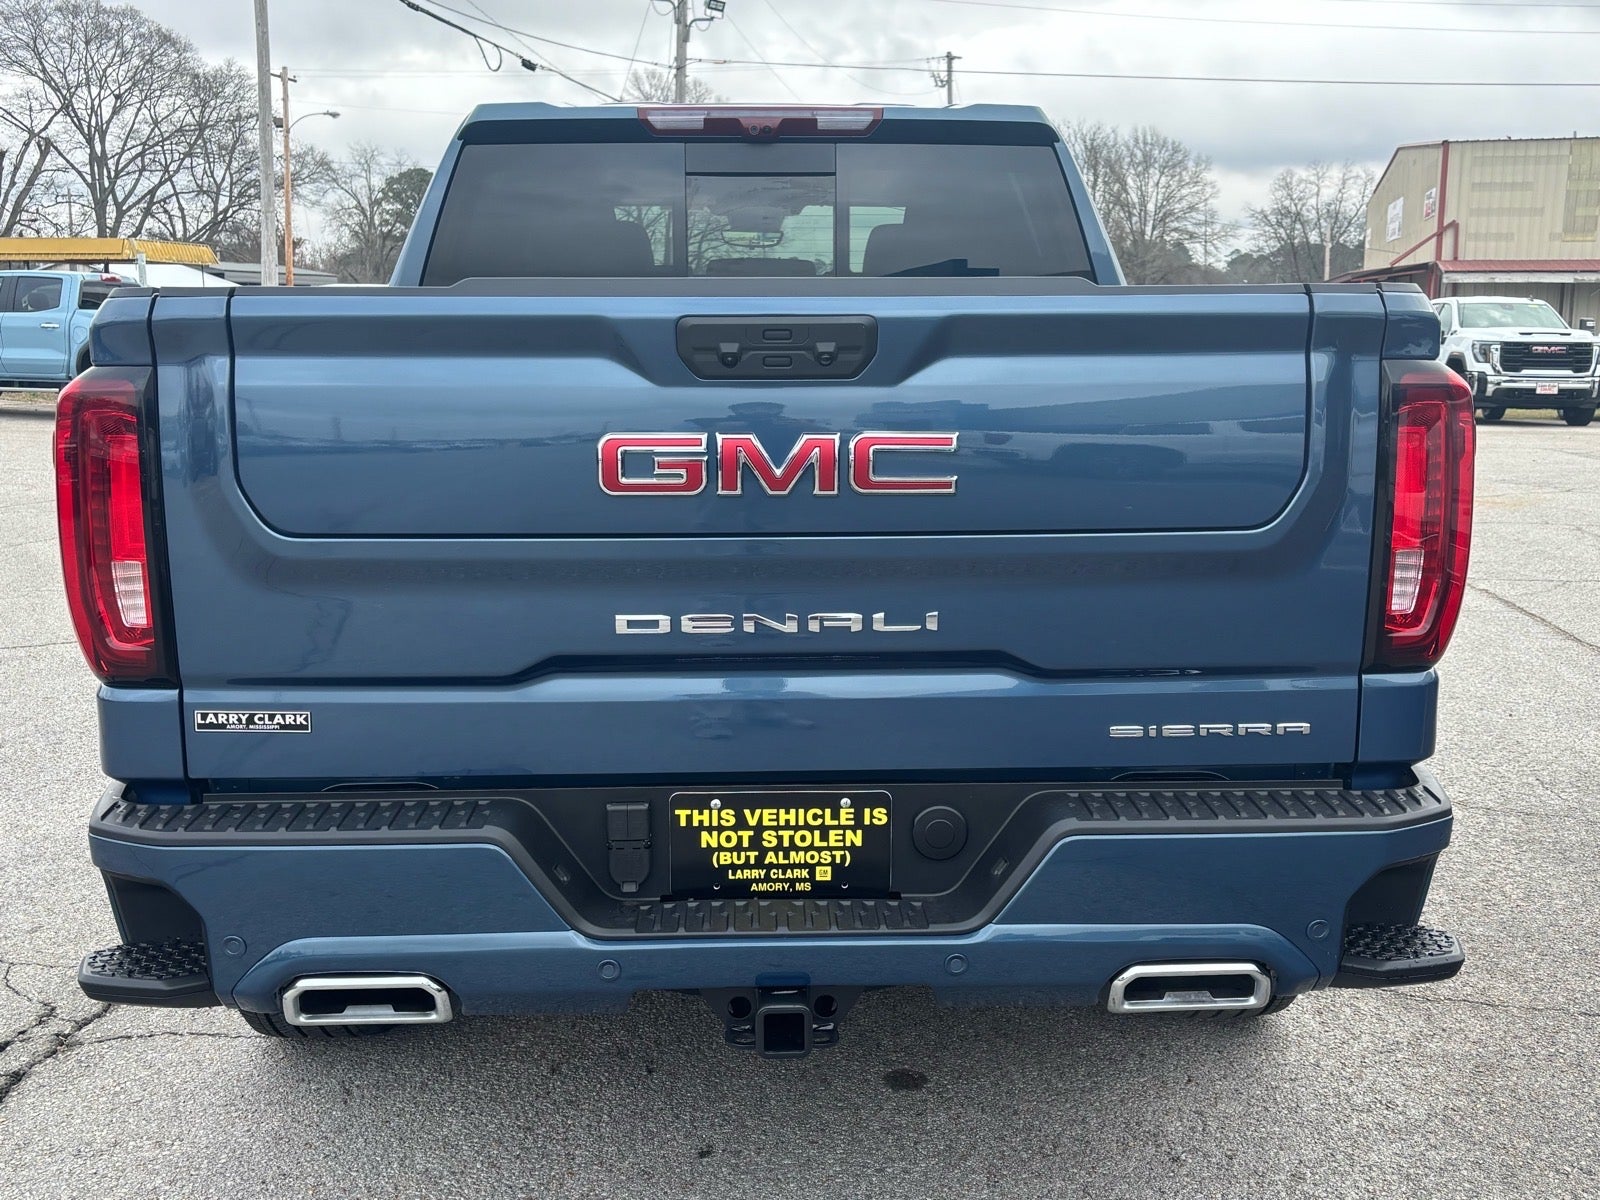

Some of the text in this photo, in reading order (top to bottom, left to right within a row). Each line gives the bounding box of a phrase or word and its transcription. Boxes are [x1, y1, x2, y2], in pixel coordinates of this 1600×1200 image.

[597, 431, 959, 496] GMC
[614, 611, 939, 635] DENALI
[197, 713, 308, 725] LARRY CLARK
[1109, 722, 1311, 738] SIERRA
[674, 807, 888, 827] THIS VEHICLE IS
[700, 829, 863, 848] NOT STOLEN
[712, 850, 851, 868] (BUT ALMOST)
[728, 868, 810, 880] LARRY CLARK
[750, 882, 812, 892] AMORY, MS
